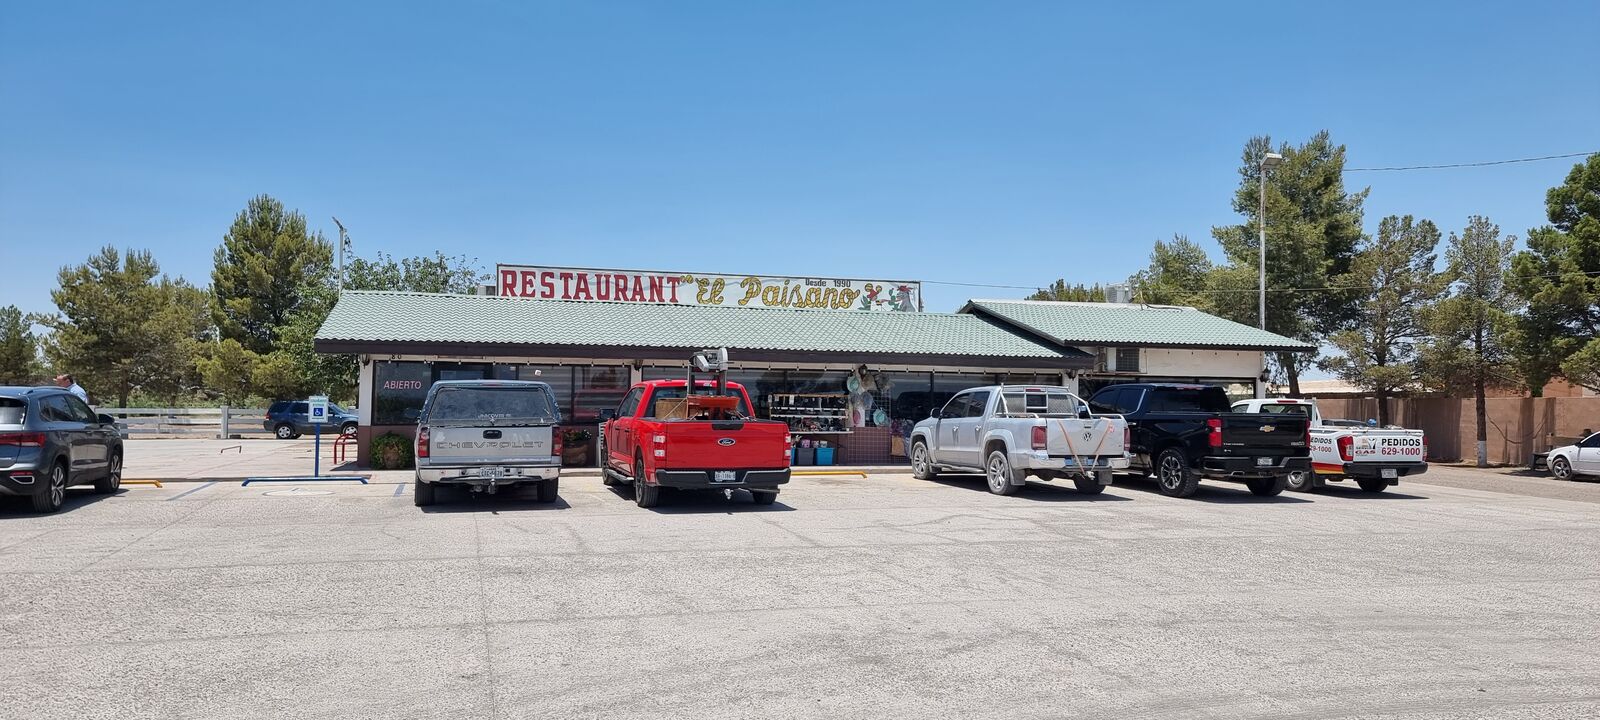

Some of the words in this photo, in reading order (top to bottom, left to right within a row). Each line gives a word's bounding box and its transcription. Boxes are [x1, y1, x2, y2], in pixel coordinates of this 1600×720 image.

[805, 278, 827, 287] Desde
[833, 279, 851, 288] 1990
[501, 269, 681, 303] RESTAURANT
[738, 276, 860, 309] Paisano
[383, 380, 422, 390] ABIERTO
[436, 441, 544, 449] CHEVROLET
[1381, 438, 1421, 447] PEDIDOS
[1381, 447, 1421, 456] 629-1000
